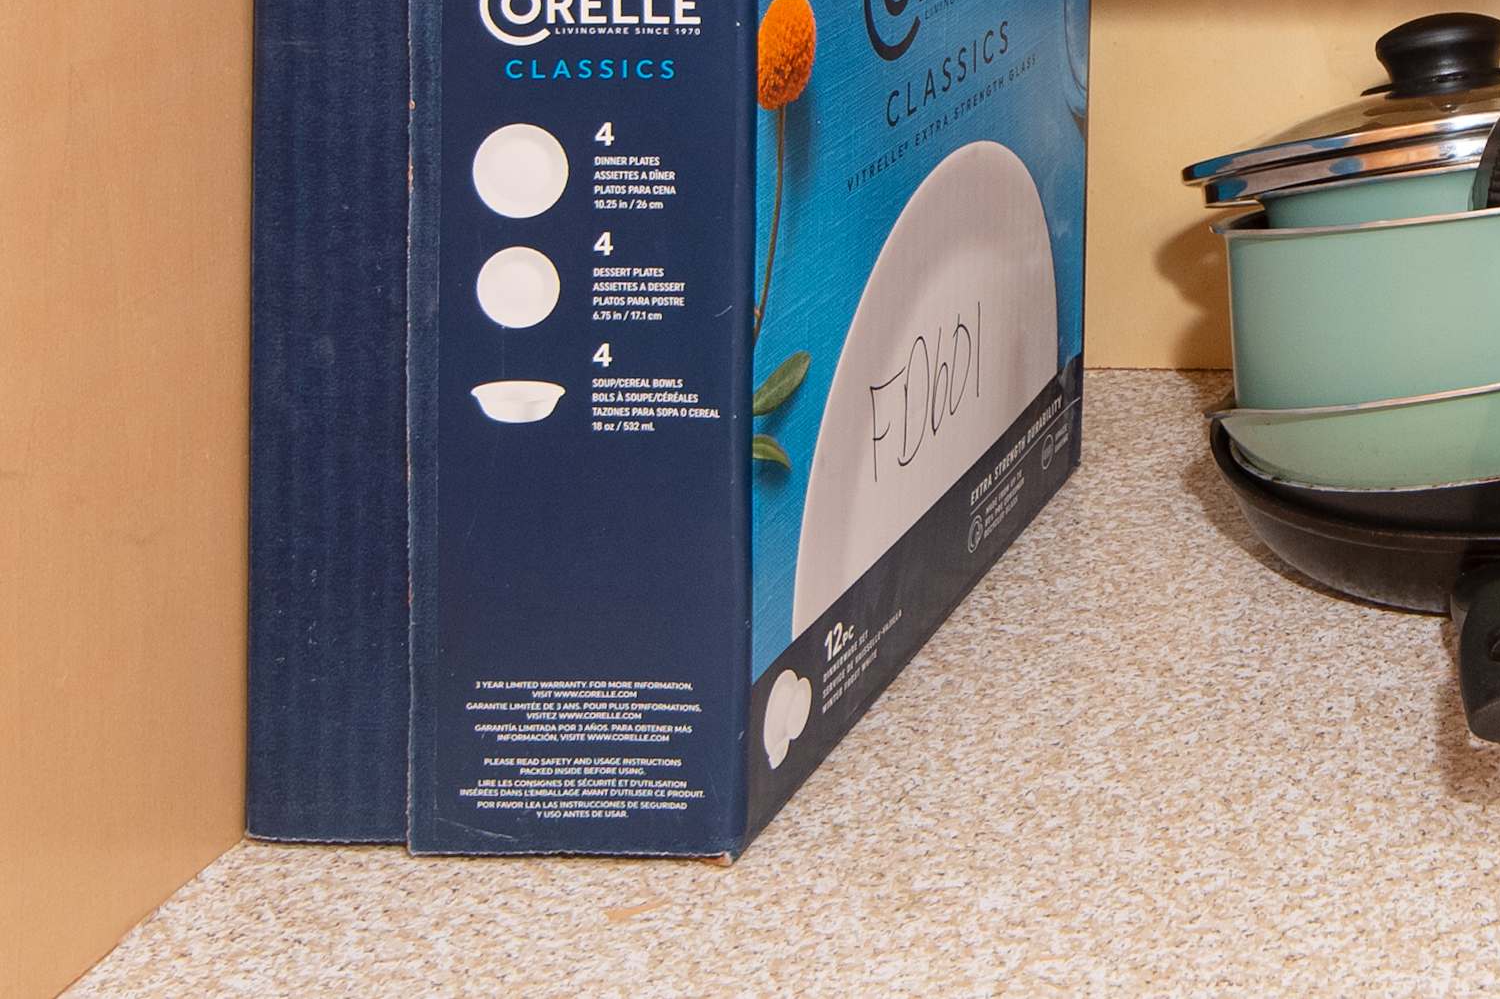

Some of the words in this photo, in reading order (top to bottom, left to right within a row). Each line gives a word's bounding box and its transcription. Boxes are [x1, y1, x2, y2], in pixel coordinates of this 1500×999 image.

[554, 27, 630, 36] LIVINGWARE
[634, 27, 670, 36] SINCE
[674, 27, 701, 36] 1970
[505, 59, 676, 80] CLASSICS
[886, 20, 1009, 127] CLASSICS
[914, 114, 949, 146] EXTRA
[953, 77, 1005, 121] STRENGTH
[593, 121, 615, 147] 4
[593, 156, 628, 166] DINNER
[629, 156, 661, 166] PLATES
[593, 170, 640, 181] ASSIETTES
[593, 185, 627, 195] PLATOS
[628, 185, 652, 195] PARA
[652, 185, 677, 195] CENA
[593, 199, 618, 210] 10.25
[619, 199, 628, 210] in
[636, 200, 648, 210] 26
[649, 201, 664, 210] cm
[593, 231, 614, 256] 4
[592, 268, 632, 277] DESSERT
[632, 268, 665, 277] PLATES
[592, 282, 639, 292] ASSIETTES
[647, 282, 686, 292] DESSERT
[592, 296, 626, 306] PLATOS
[626, 296, 650, 306] PARA
[651, 297, 685, 307] POSTRE
[592, 310, 612, 321] 6.75
[612, 310, 622, 321] in
[630, 310, 647, 321] 17.1
[647, 312, 663, 321] cm
[592, 342, 613, 367] 4
[592, 378, 651, 389] SOUP/CEREAL
[652, 378, 684, 389] BOWLS
[592, 392, 616, 403] BOLS
[592, 407, 631, 417] TAZONES
[631, 407, 656, 417] PARA
[656, 407, 680, 418] SOPA
[680, 408, 688, 418] O
[688, 408, 721, 419] CEREAL
[592, 421, 603, 432] 18
[603, 423, 615, 431] oz
[623, 421, 640, 432] 532
[970, 473, 993, 506] EXTRA
[994, 434, 1026, 480] STRENGTH
[1027, 394, 1063, 444] DURABILITY
[482, 681, 505, 689] YEAR
[505, 681, 539, 689] LIMITED
[589, 681, 607, 689] FOR
[608, 681, 633, 689] MORE
[531, 690, 553, 699] VISIT
[553, 690, 638, 699] WWW.CORELLE.COM
[465, 702, 508, 711] GARANTIE
[543, 702, 555, 711] DE
[583, 702, 608, 711] POUR
[608, 702, 630, 711] PLUS
[526, 712, 558, 720] VISITEZ
[558, 712, 642, 720] WWW.CORELLE.COM
[518, 724, 557, 732] LIMITADA
[557, 724, 577, 732] POR
[611, 724, 634, 732] PARA
[634, 724, 673, 733] OBTENER
[559, 733, 586, 741] VISITE
[586, 733, 670, 742] WWW.CORELLE.COM
[483, 758, 515, 766] PLEASE
[516, 758, 540, 766] READ
[540, 758, 572, 766] SAFETY
[573, 758, 592, 766] AND
[593, 758, 622, 766] USAGE
[622, 758, 682, 767] INSTRUCTIONS
[520, 767, 554, 775] PACKED
[554, 767, 583, 775] INSIDE
[583, 767, 617, 775] BEFORE
[478, 779, 497, 787] LIRE
[498, 779, 513, 787] LES
[513, 779, 563, 787] CONSIGNES
[564, 779, 576, 787] DE
[618, 779, 628, 787] ET
[500, 788, 523, 797] DANS
[581, 788, 609, 797] AVANT
[654, 789, 666, 798] CE
[476, 801, 495, 809] POR
[495, 801, 525, 809] FAVOR
[525, 801, 541, 809] LEA
[542, 801, 558, 809] LAS
[559, 801, 626, 809] INSTRUCCIONES
[627, 801, 640, 810] DE
[640, 801, 688, 811] SEGURIDAD
[536, 810, 543, 819] Y
[543, 810, 562, 818] USO
[562, 810, 591, 818] ANTES
[591, 810, 604, 818] DE
